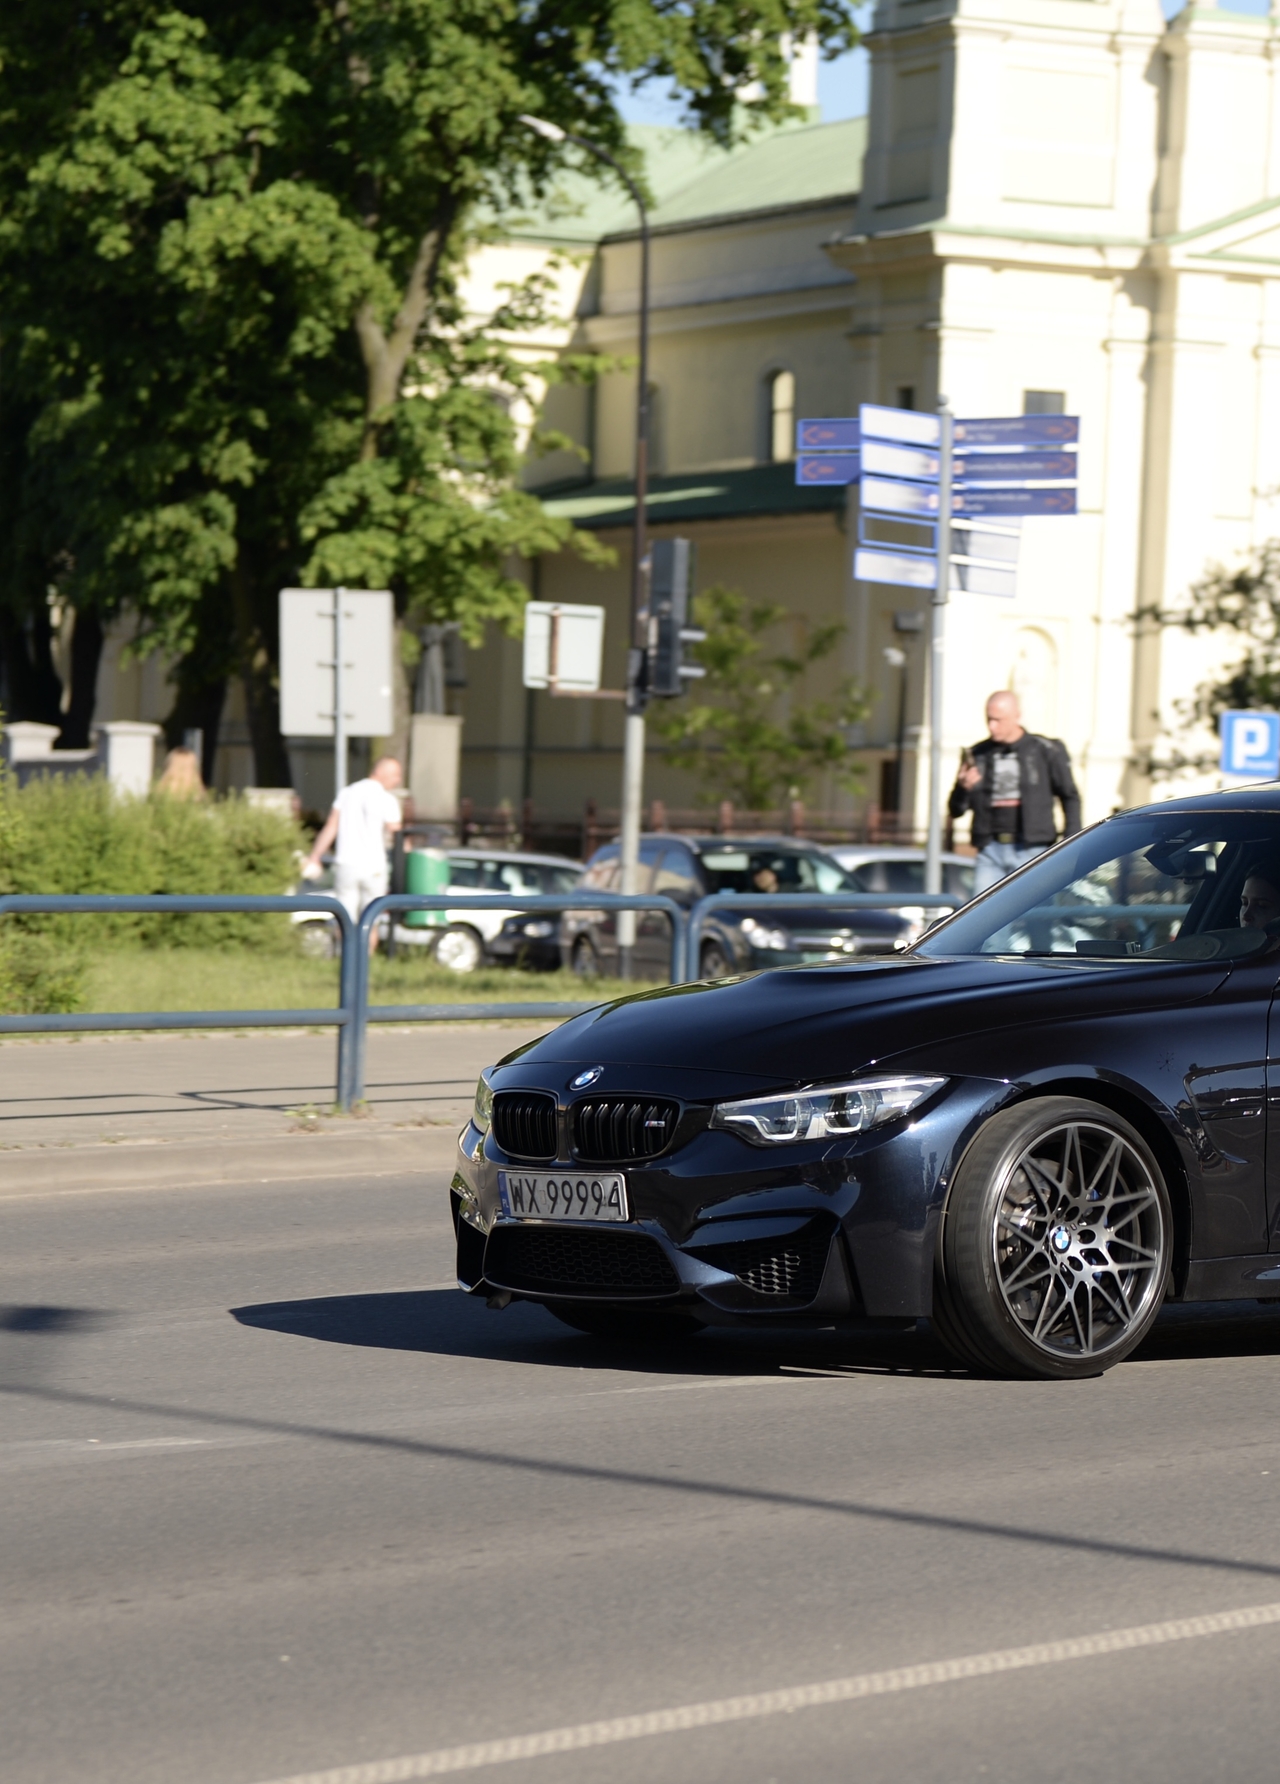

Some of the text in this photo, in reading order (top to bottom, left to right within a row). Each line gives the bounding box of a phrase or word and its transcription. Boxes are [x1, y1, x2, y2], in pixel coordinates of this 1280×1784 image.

[1232, 718, 1270, 769] P
[509, 1178, 622, 1216] WX 99994
